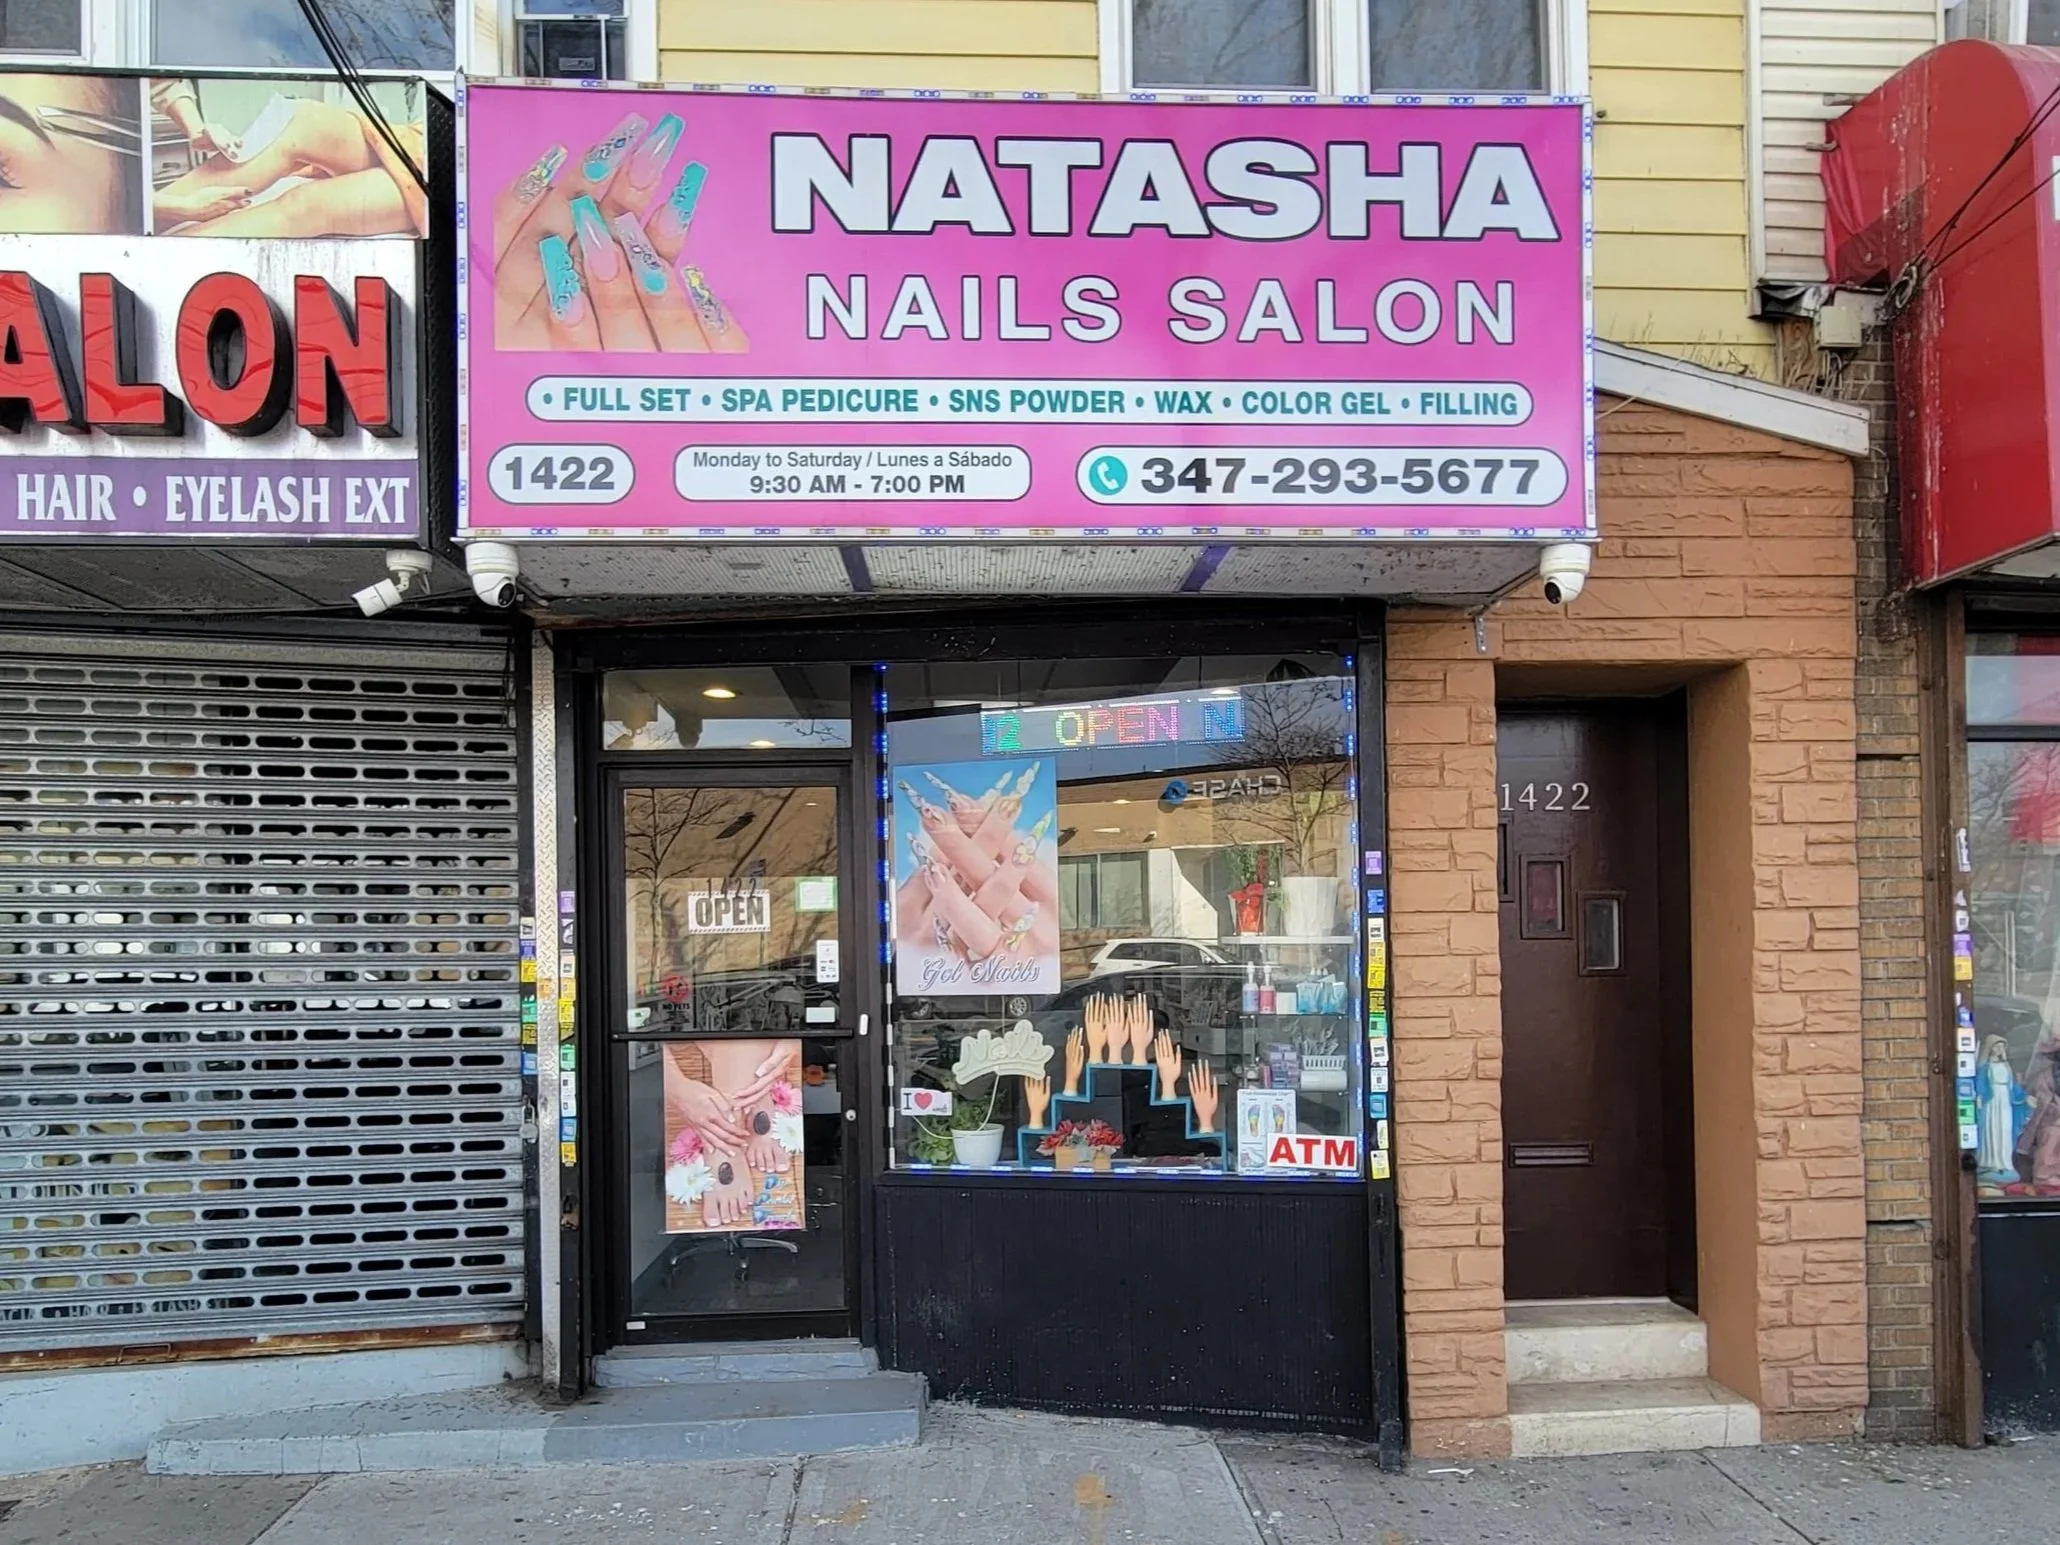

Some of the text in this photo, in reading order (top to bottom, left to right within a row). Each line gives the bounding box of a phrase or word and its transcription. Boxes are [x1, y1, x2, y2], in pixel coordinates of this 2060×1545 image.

[771, 132, 1562, 242] NATASHA
[806, 274, 1515, 346] NAILS SALON
[564, 387, 1519, 415] FULL SET SPA PEDICURE SNS POWDER WAX COLOR GEL FILLING
[505, 456, 615, 491] 1422
[693, 450, 1013, 471] Monday to Saturday / Lunes a Sábado
[1141, 457, 1541, 495] 347-293-5677
[17, 473, 411, 524] HAIR EYELASH EXT
[749, 474, 802, 495] 9:30
[809, 475, 847, 494] AM
[871, 475, 921, 494] 7:00
[929, 475, 966, 494] PM
[1055, 705, 1181, 747] OPEN
[1500, 782, 1591, 811] 1422
[695, 896, 764, 927] OPEN
[971, 954, 1040, 984] Nails
[1269, 1136, 1356, 1167] ATM
